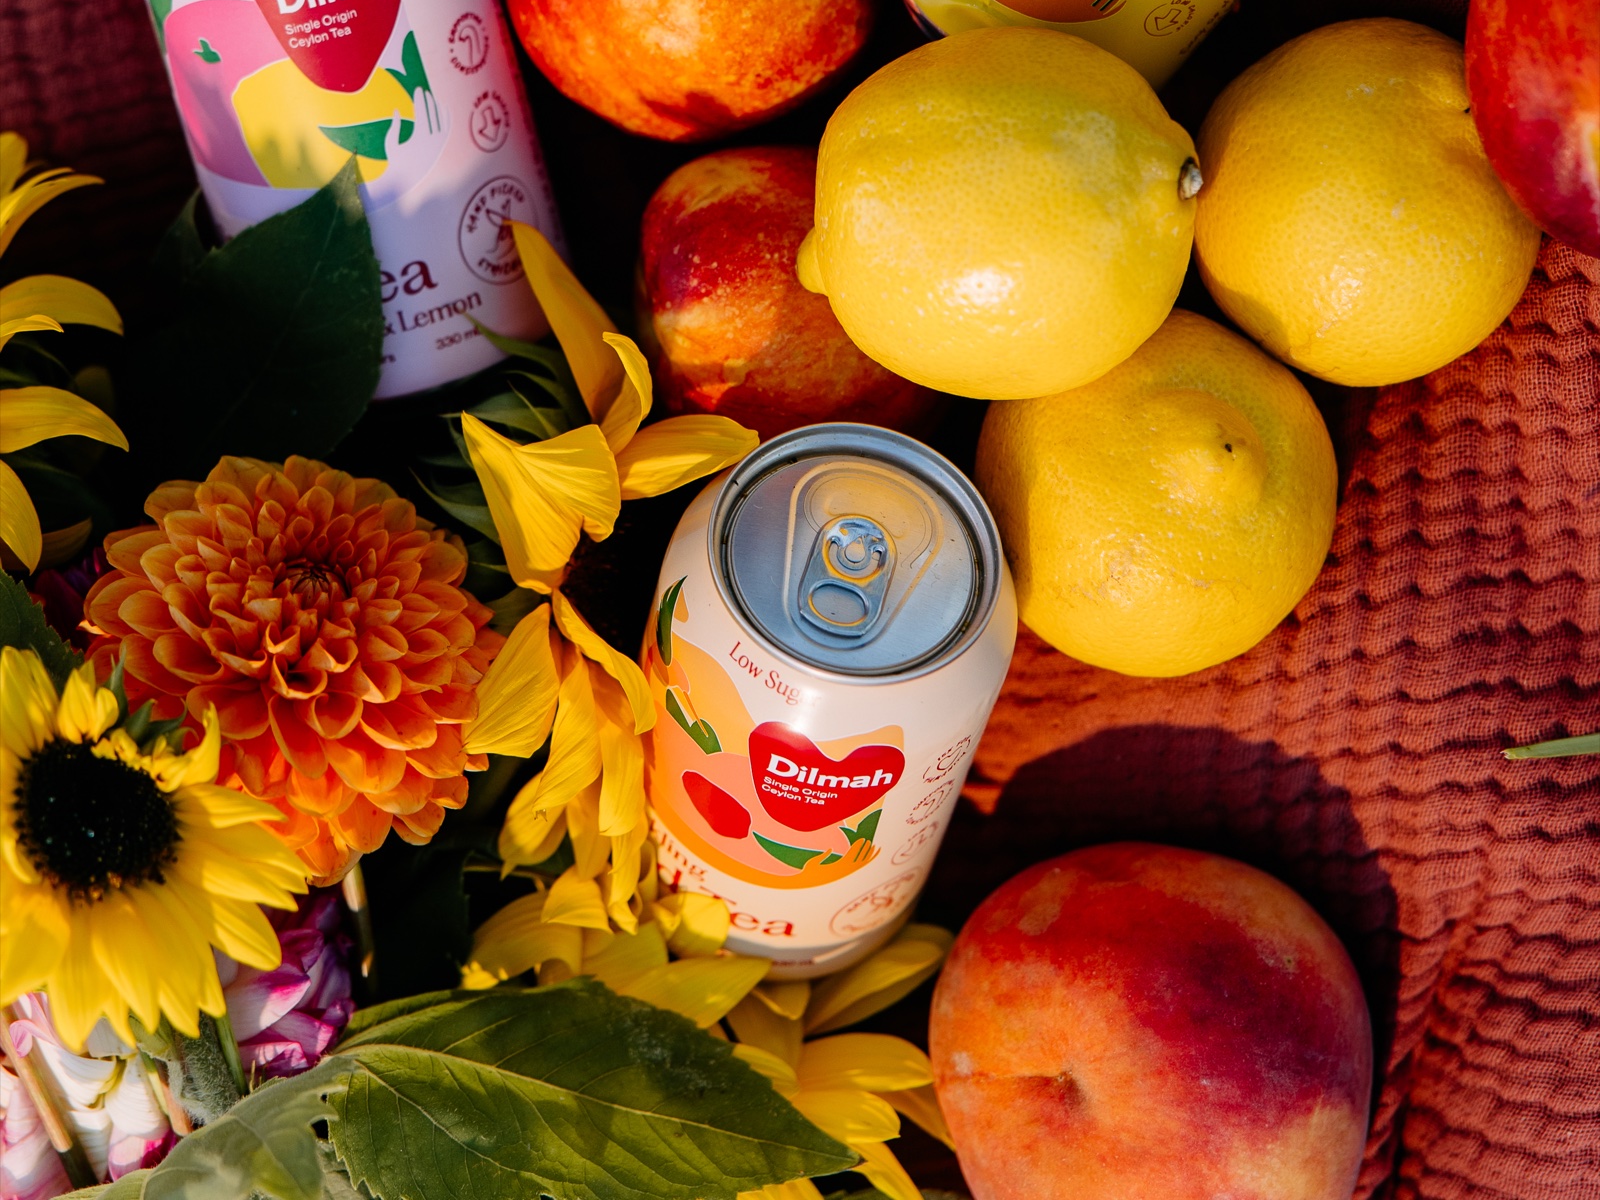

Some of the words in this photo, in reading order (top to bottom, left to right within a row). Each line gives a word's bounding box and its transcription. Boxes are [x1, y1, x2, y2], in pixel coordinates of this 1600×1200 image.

[284, 17, 321, 36] Single
[321, 8, 358, 28] Origin
[288, 31, 329, 49] Ceylon
[329, 25, 352, 40] Tea
[381, 260, 438, 304] ea
[396, 291, 483, 332] Lemon
[729, 640, 764, 678] Low
[765, 752, 894, 789] Dilmah
[761, 783, 801, 802] Ceylon
[803, 795, 825, 806] Tea
[763, 776, 800, 793] Single
[802, 788, 839, 800] Origin
